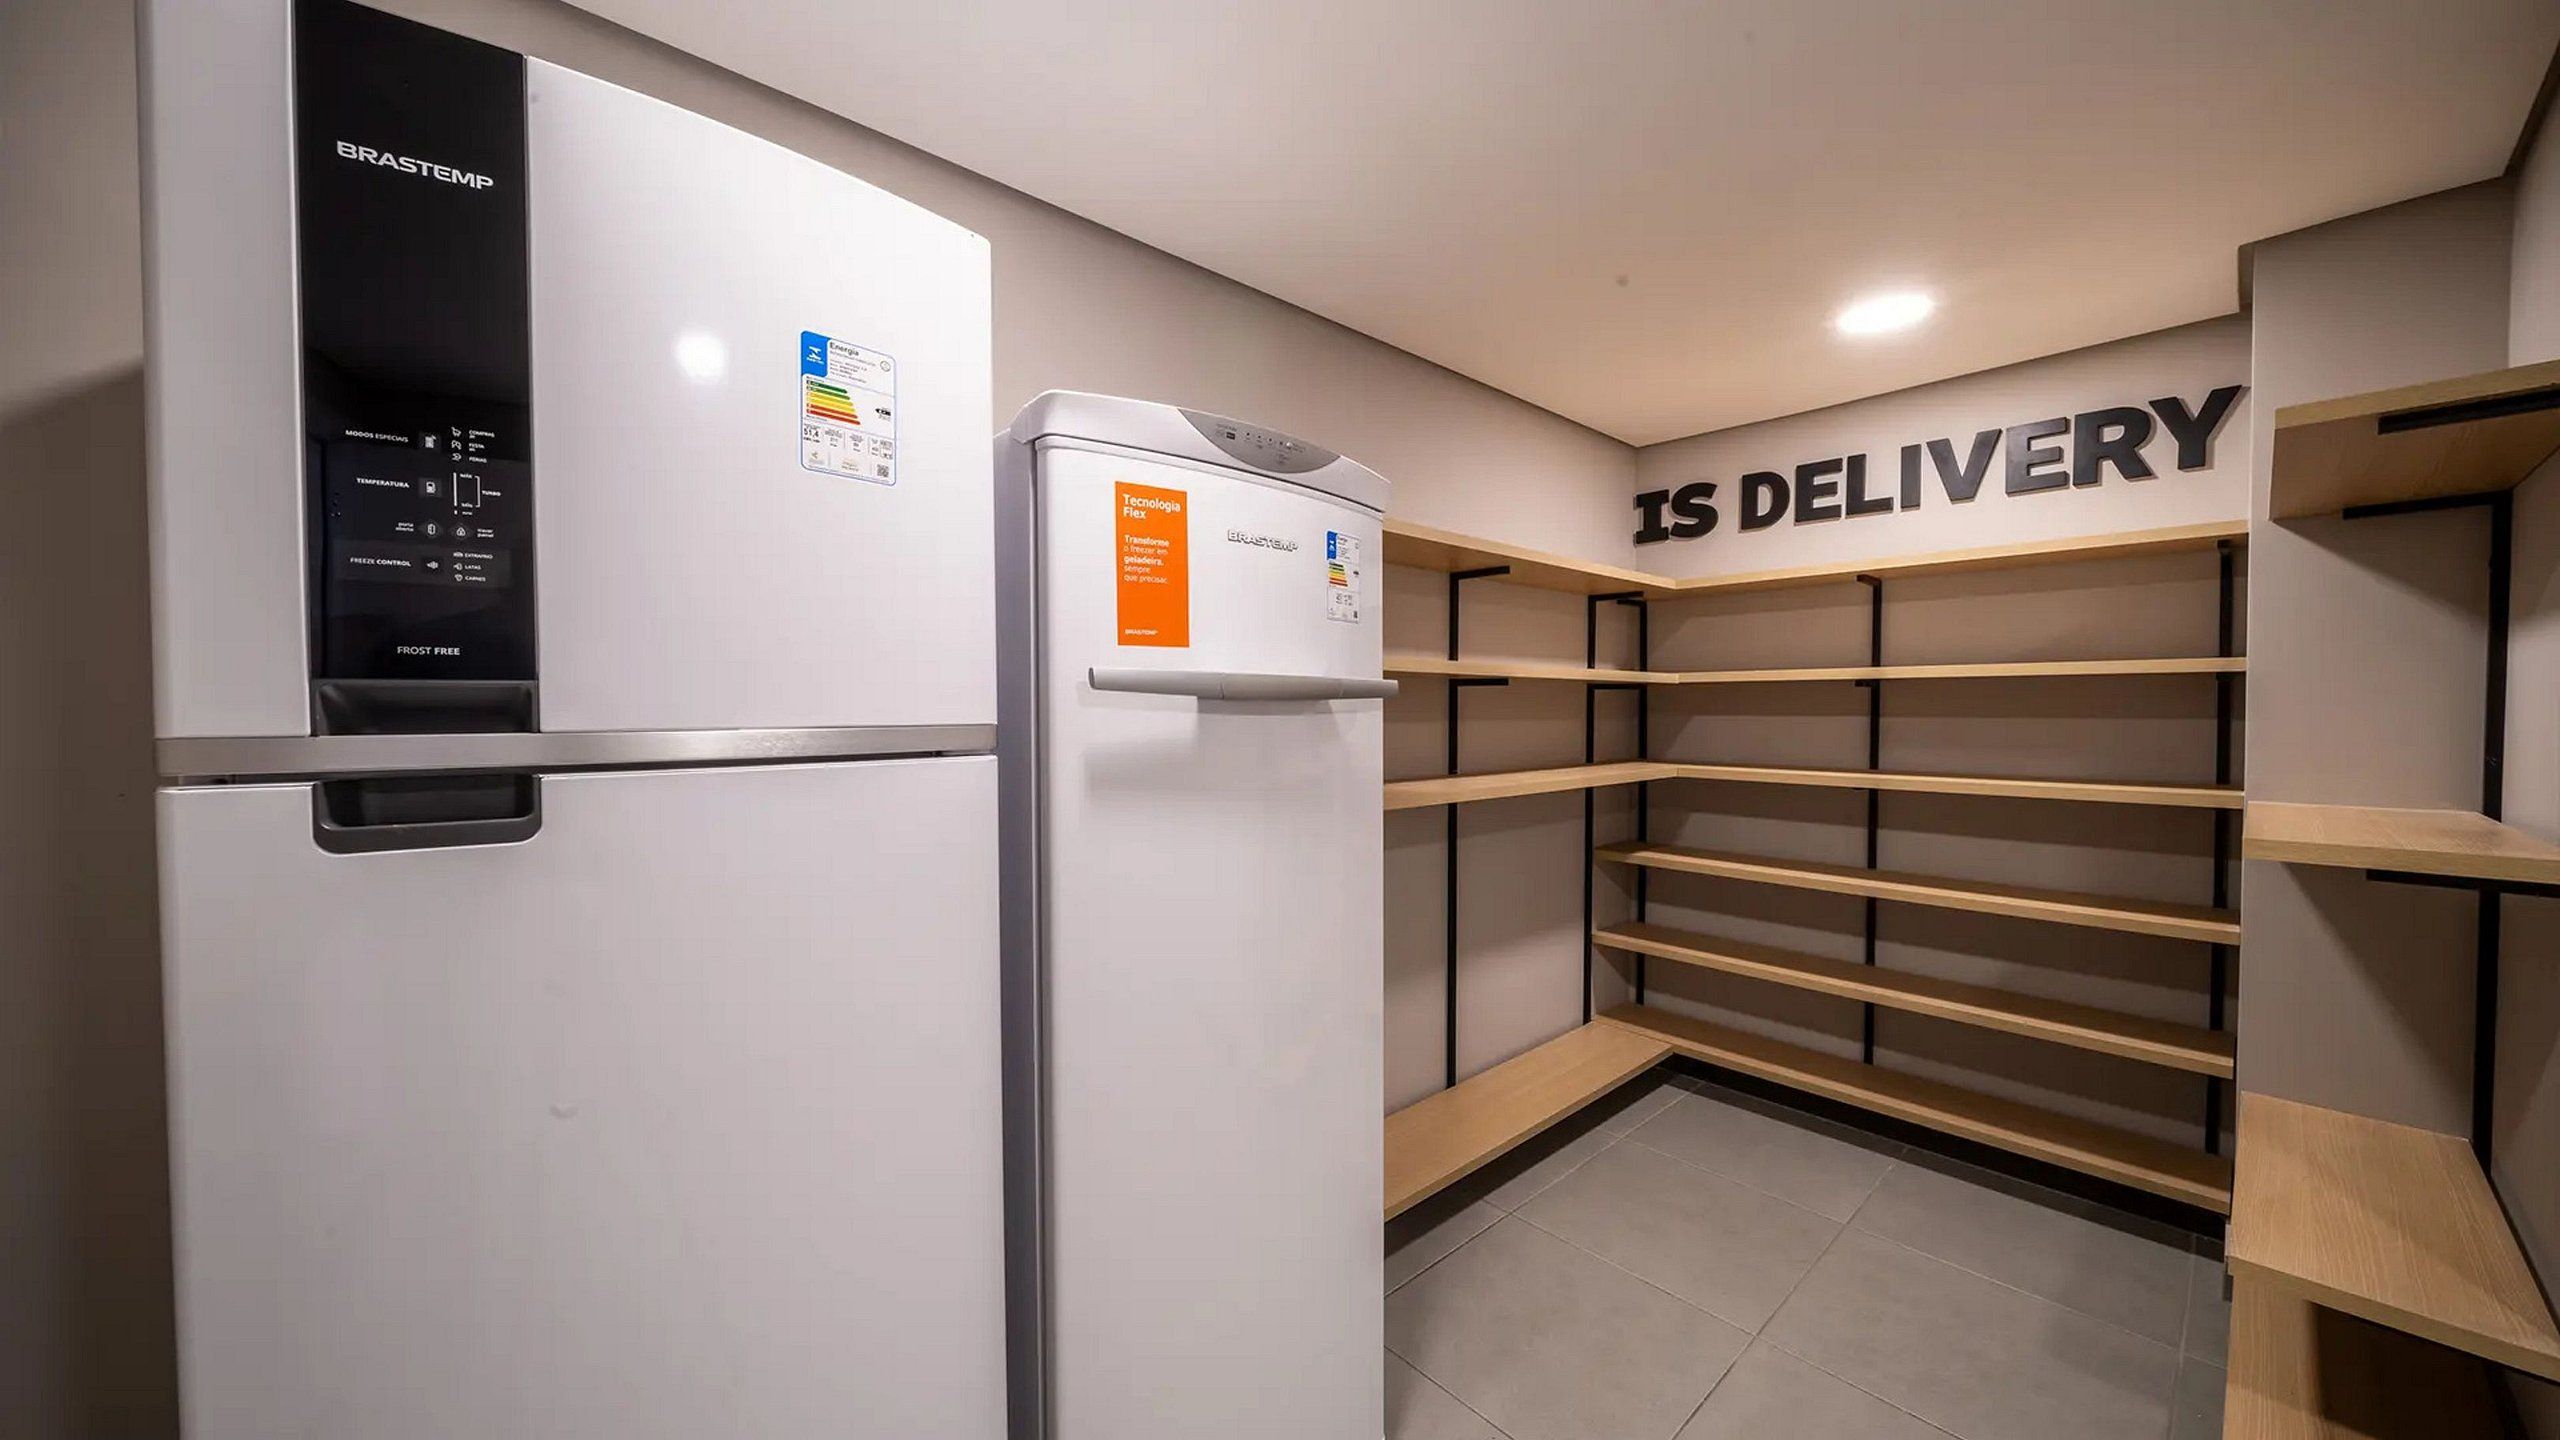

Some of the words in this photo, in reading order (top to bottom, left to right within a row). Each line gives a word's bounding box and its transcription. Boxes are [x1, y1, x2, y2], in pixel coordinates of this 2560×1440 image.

[337, 141, 494, 189] BRASTEMP
[345, 430, 374, 439] MODOS
[375, 434, 409, 443] ESPECIAIS
[1635, 482, 1719, 546] IS
[1738, 385, 2249, 532] DELIVERY
[356, 478, 410, 488] TEMPERATURA
[1123, 494, 1181, 513] Tecnologia
[1123, 507, 1147, 519] Flex
[1124, 534, 1169, 547] Transforme
[1227, 529, 1298, 552] BRASTEMP
[350, 557, 375, 566] FREEZE
[376, 558, 411, 567] CONTROL
[1124, 574, 1138, 583] que
[397, 646, 431, 655] FROST
[434, 647, 460, 655] FREE
